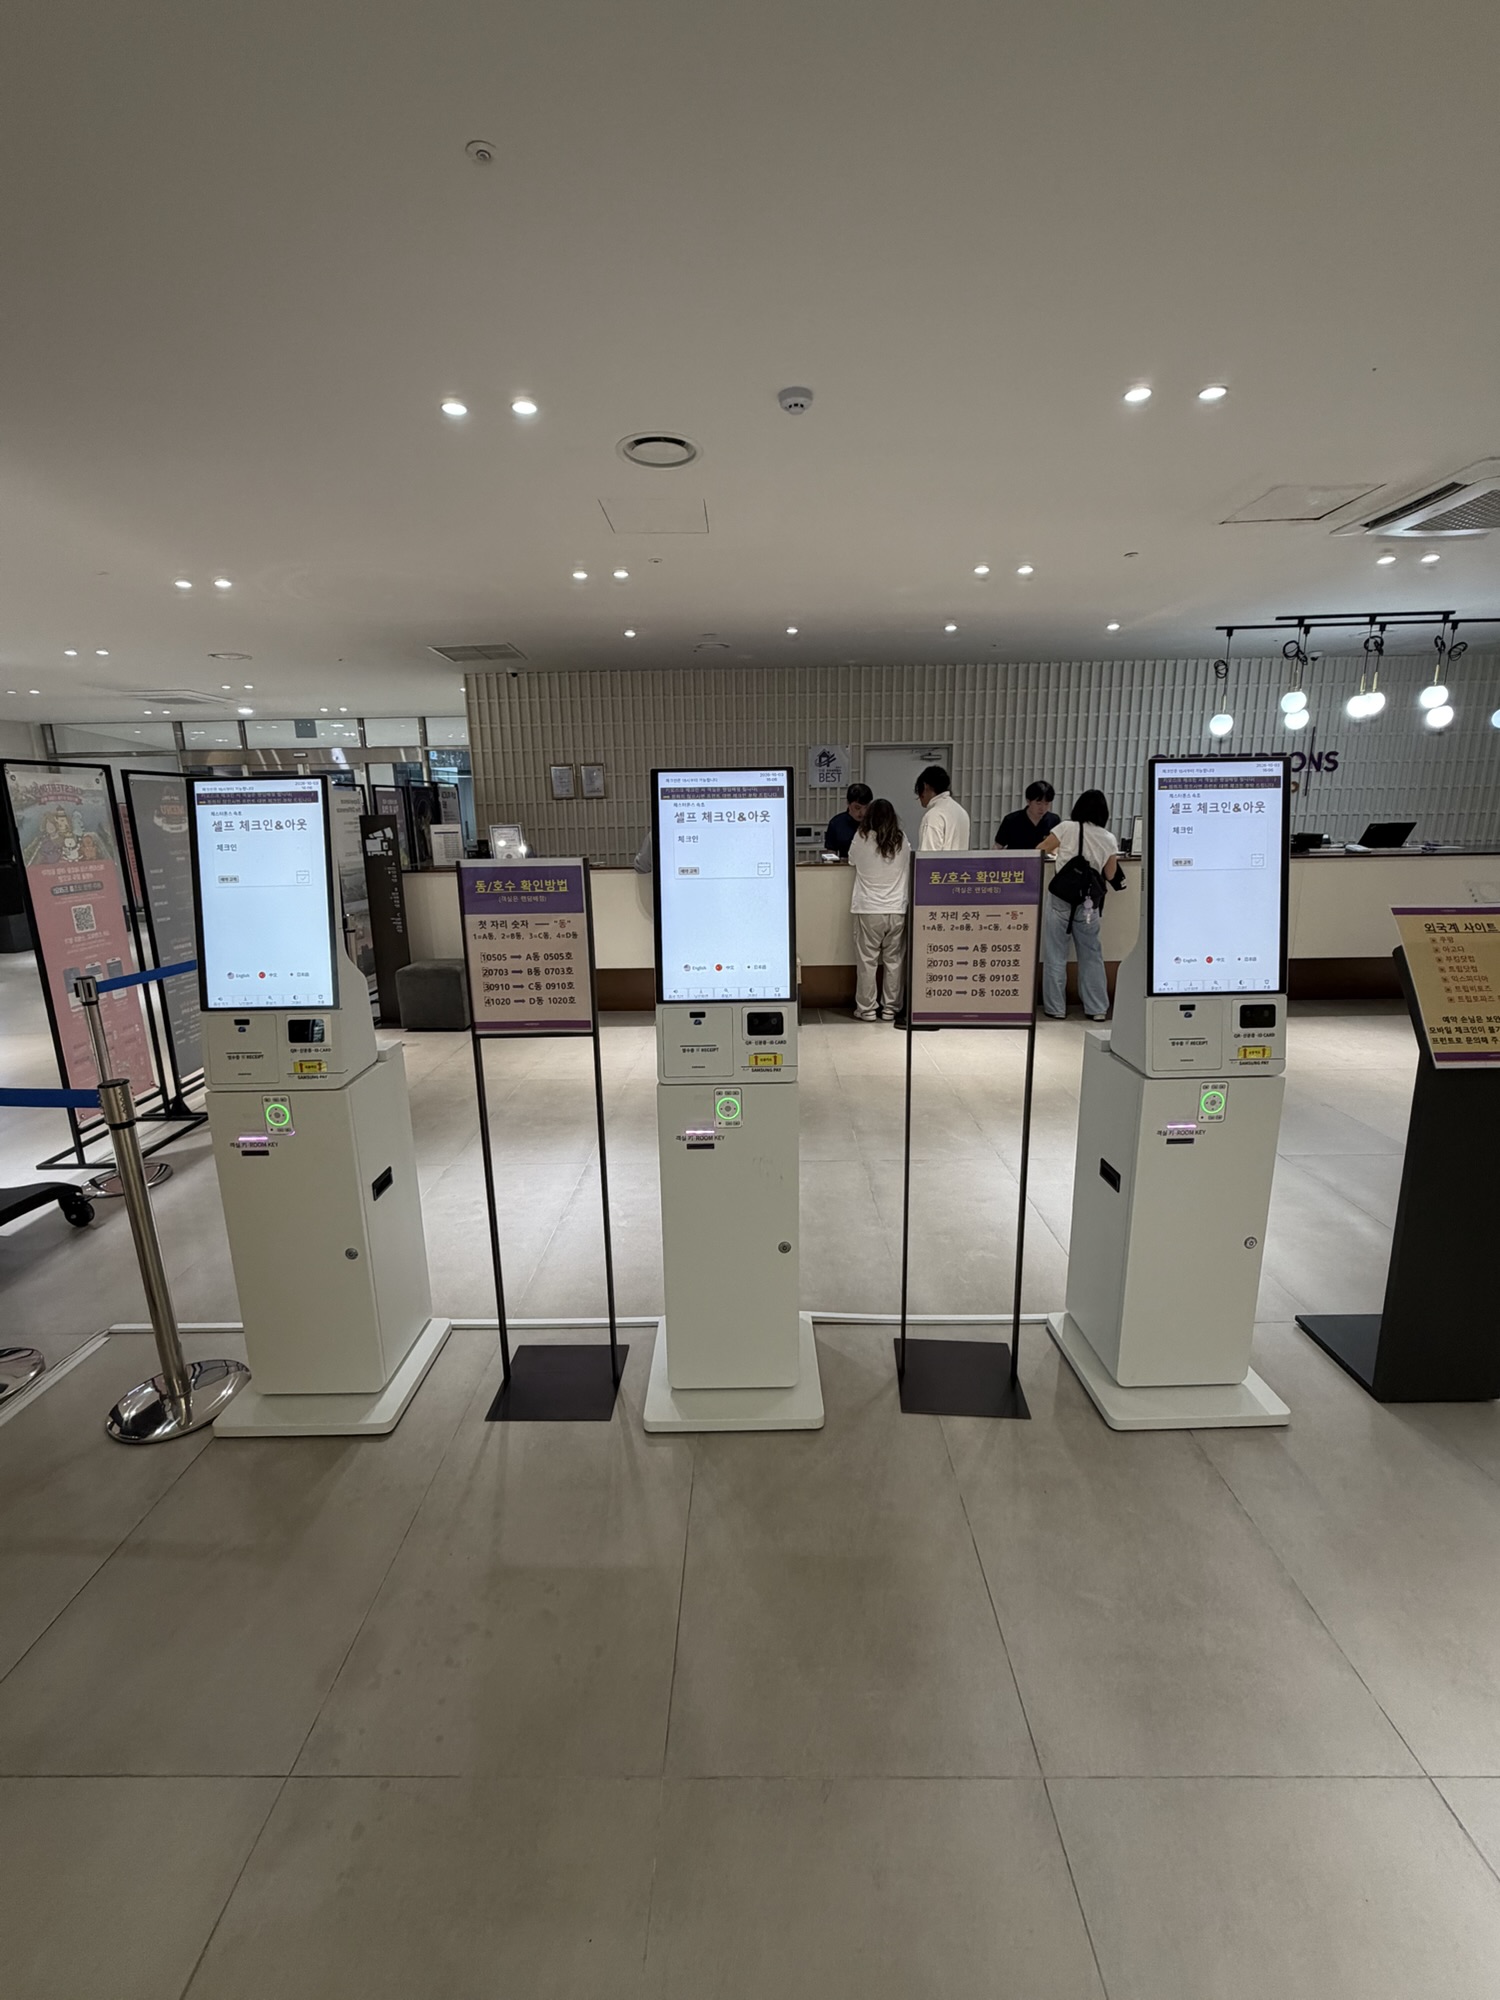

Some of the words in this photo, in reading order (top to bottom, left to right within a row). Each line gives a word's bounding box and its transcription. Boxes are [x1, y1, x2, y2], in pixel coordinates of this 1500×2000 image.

[818, 772, 842, 782] BEST
[1169, 802, 1193, 815] 셀프
[1197, 801, 1266, 814] 체크인&아웃
[674, 811, 697, 823] 셀프
[701, 810, 770, 823] 체크인&아웃
[212, 819, 235, 832] 셀프
[239, 818, 307, 832] 체크인&아웃
[1172, 826, 1194, 835] 체크인
[677, 835, 699, 843] 체크인
[216, 843, 238, 852] 체크인
[930, 871, 971, 884] 동/호수
[976, 870, 1025, 883] 확인방법
[475, 880, 515, 892] 동/호수
[520, 879, 568, 892] 확인방법
[974, 886, 1001, 894] 랜덤배정)
[928, 911, 937, 921] 첫
[940, 911, 959, 921] 자리
[962, 911, 980, 920] 숫자
[478, 920, 487, 929] 첫
[490, 920, 508, 929] 자리
[512, 920, 529, 929] 숫자
[922, 924, 946, 932] 1=A동,
[950, 924, 974, 932] 2=B동,
[978, 924, 1002, 932] 3=C동,
[1007, 924, 1029, 932] 4=D동
[1424, 923, 1459, 933] 외국계
[1464, 922, 1498, 933] 사이트
[473, 932, 497, 941] 1=A동,
[501, 932, 524, 940] 2=B동,
[529, 932, 552, 940] 3=C동,
[556, 931, 578, 939] 4=D동
[928, 944, 954, 953] 10505
[972, 944, 988, 953] A동
[991, 944, 1021, 952] 0505호
[481, 953, 507, 961] 10505
[526, 952, 540, 961] A동
[543, 952, 573, 961] 0505호
[1445, 955, 1475, 963] 부킹닷컴
[928, 959, 954, 967] 20703
[972, 958, 987, 968] B동
[990, 958, 1020, 967] 0703호
[482, 968, 509, 976] 20703
[527, 967, 541, 976] B동
[544, 967, 574, 976] 0703호
[1448, 965, 1478, 973] 트립닷컴
[928, 974, 953, 982] 30910
[972, 973, 986, 982] C동
[989, 973, 1020, 982] 0910호
[1450, 975, 1489, 983] 익스피디아
[484, 982, 510, 991] 30910
[528, 982, 542, 991] C동
[545, 981, 575, 990] 0910호
[926, 988, 953, 997] 41020
[971, 988, 986, 997] D동
[990, 988, 1020, 997] 1020호
[486, 997, 511, 1006] 41020
[529, 997, 544, 1006] D동
[548, 996, 576, 1005] 1020호
[1442, 1016, 1458, 1024] 예약
[1461, 1016, 1483, 1024] 손님은
[1430, 1026, 1452, 1034] 모바일
[1454, 1026, 1486, 1034] 체크인이
